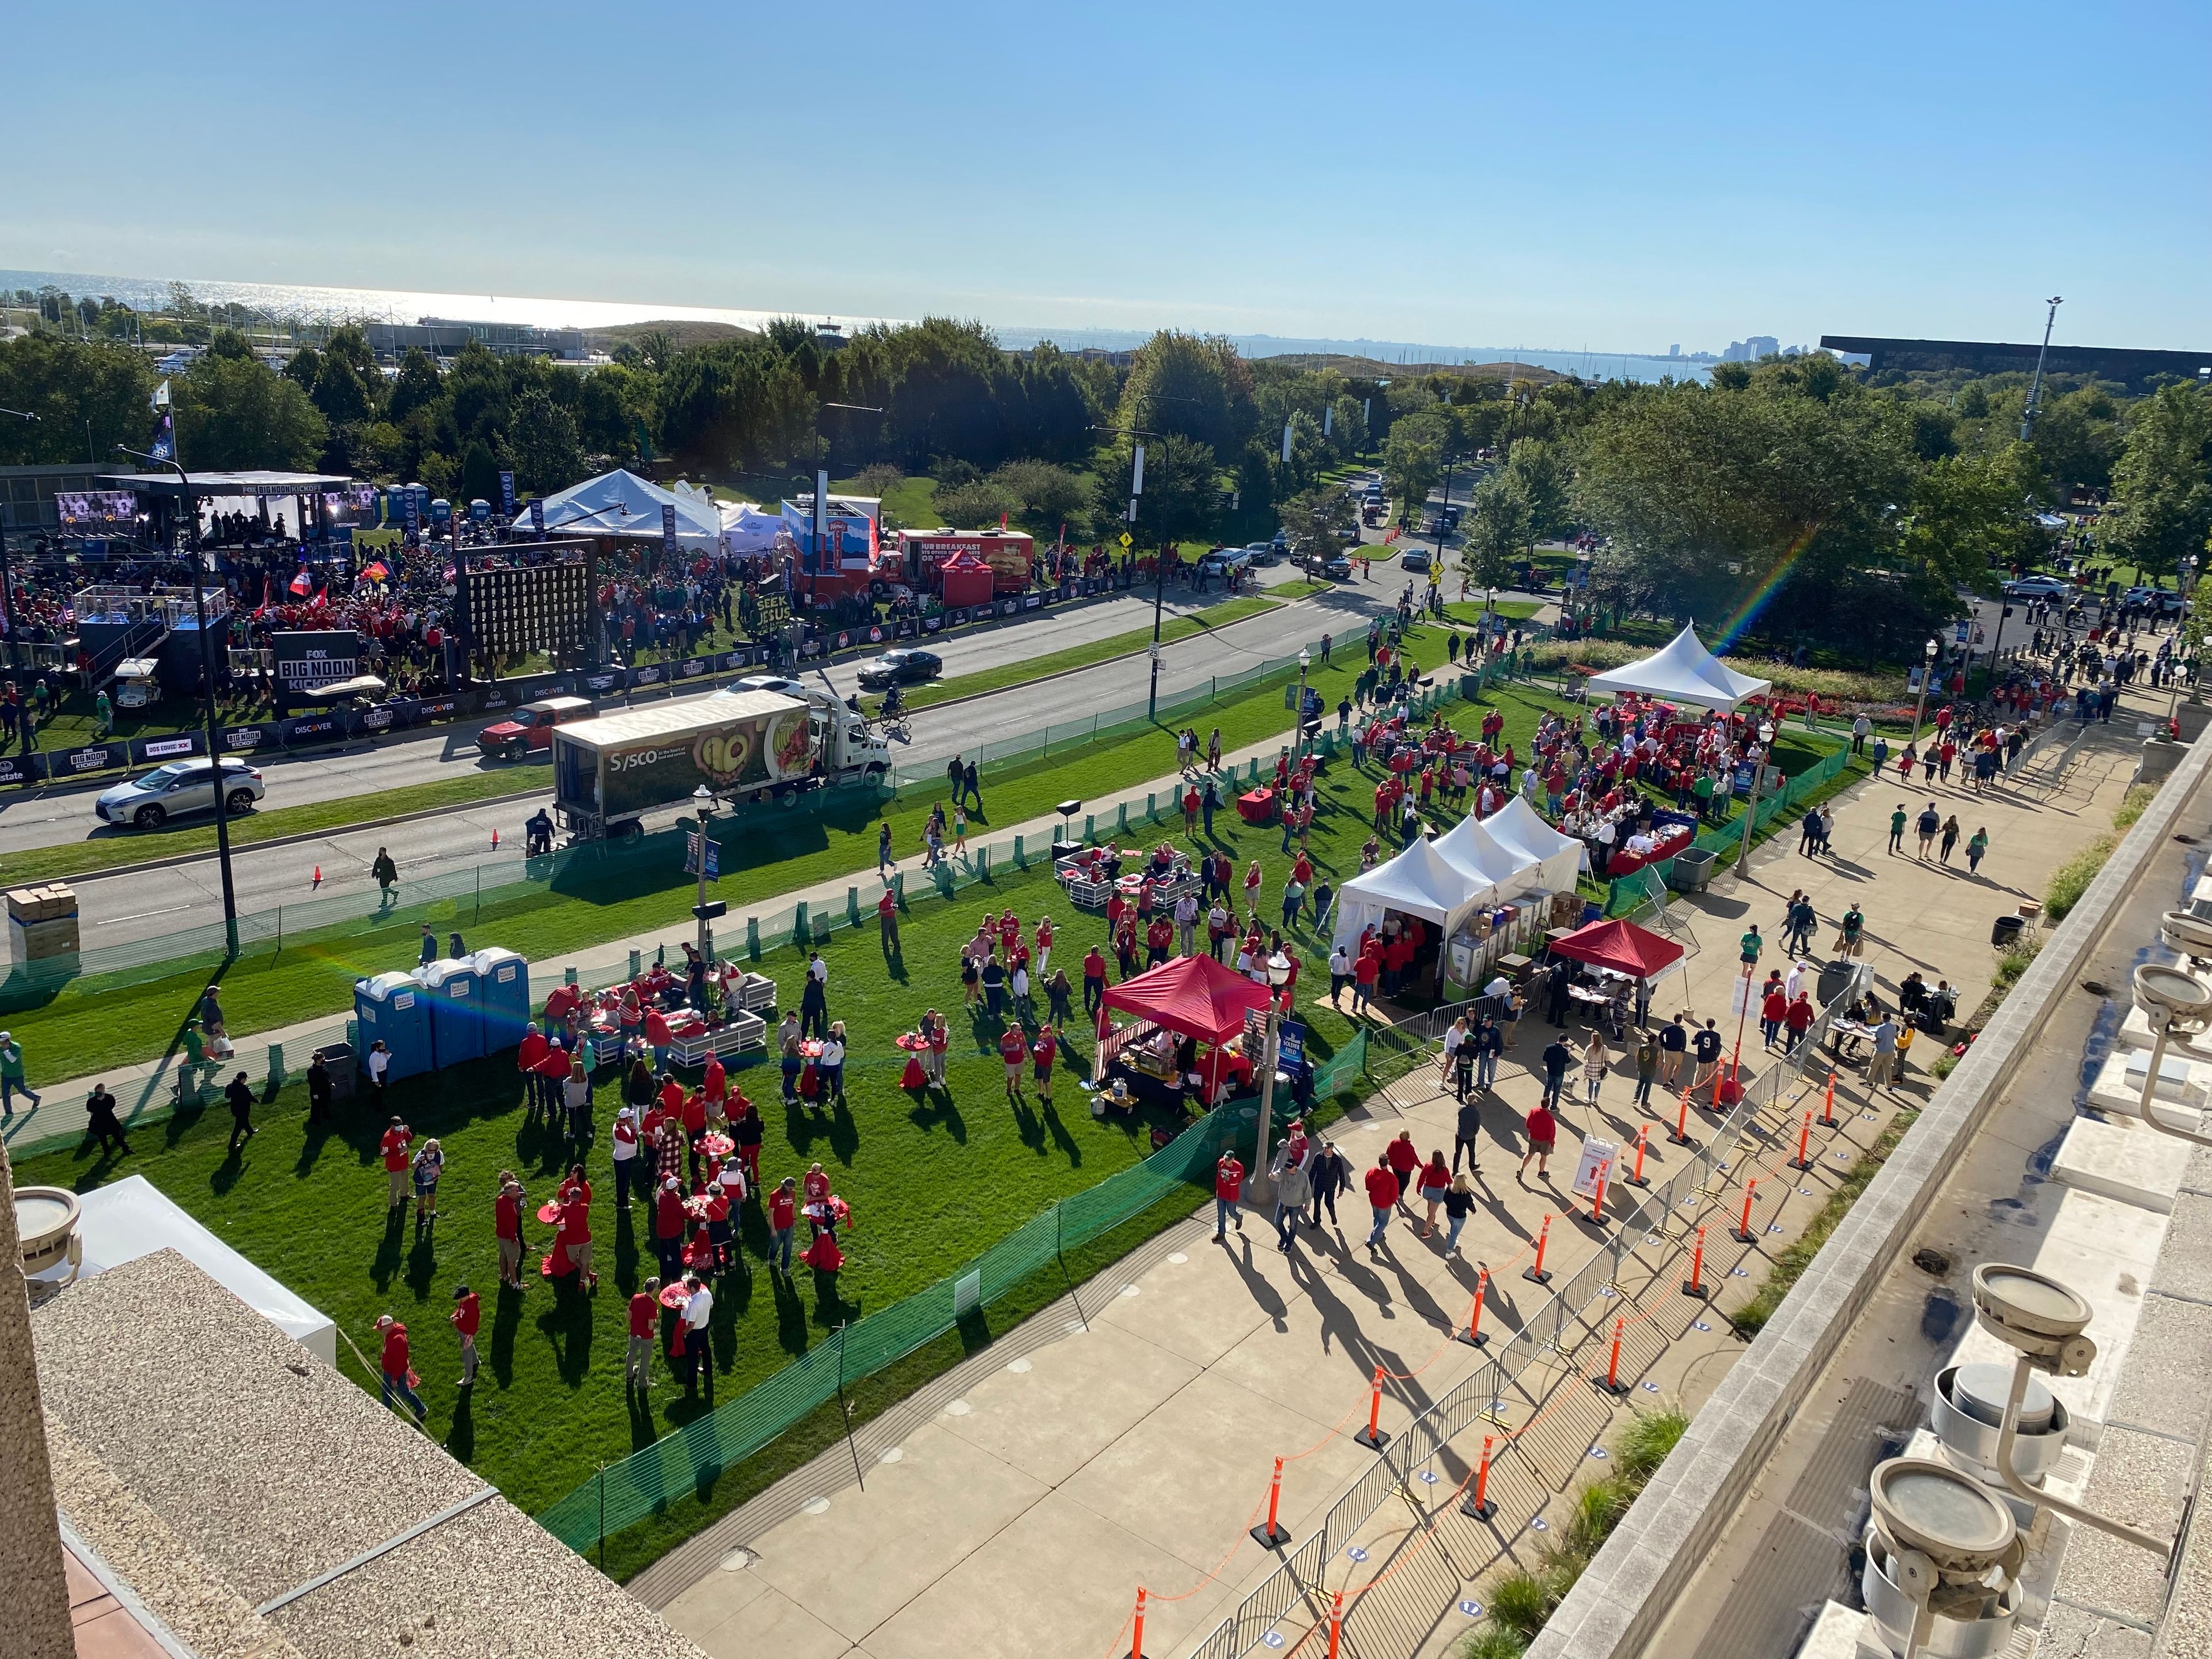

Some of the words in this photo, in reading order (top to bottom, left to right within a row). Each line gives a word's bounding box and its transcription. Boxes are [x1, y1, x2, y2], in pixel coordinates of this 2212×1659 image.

[757, 595, 788, 611] SEEK
[757, 607, 790, 626] JESUS
[306, 650, 327, 659] FOX
[282, 662, 308, 677] BIG
[311, 660, 353, 676] NOON
[692, 662, 704, 671] NOON
[647, 670, 659, 678] NOON
[535, 686, 564, 696] DISCOVER
[1397, 687, 1404, 695] 10
[421, 703, 454, 714] DISCOVER
[485, 699, 507, 709] Allstate
[365, 714, 374, 722] BIG
[375, 711, 392, 721] NOON
[295, 722, 332, 734] DISCOVER
[241, 732, 260, 741] NOON
[72, 754, 84, 763] BIG
[86, 752, 107, 762] NOON
[75, 760, 104, 769] KICKOFF
[1659, 960, 1680, 978] EMPLOYEES
[1283, 1040, 1300, 1050] SOLDIER
[1703, 1037, 1711, 1048] 9
[1285, 1047, 1297, 1055] FIELD
[1643, 1050, 1650, 1061] 9
